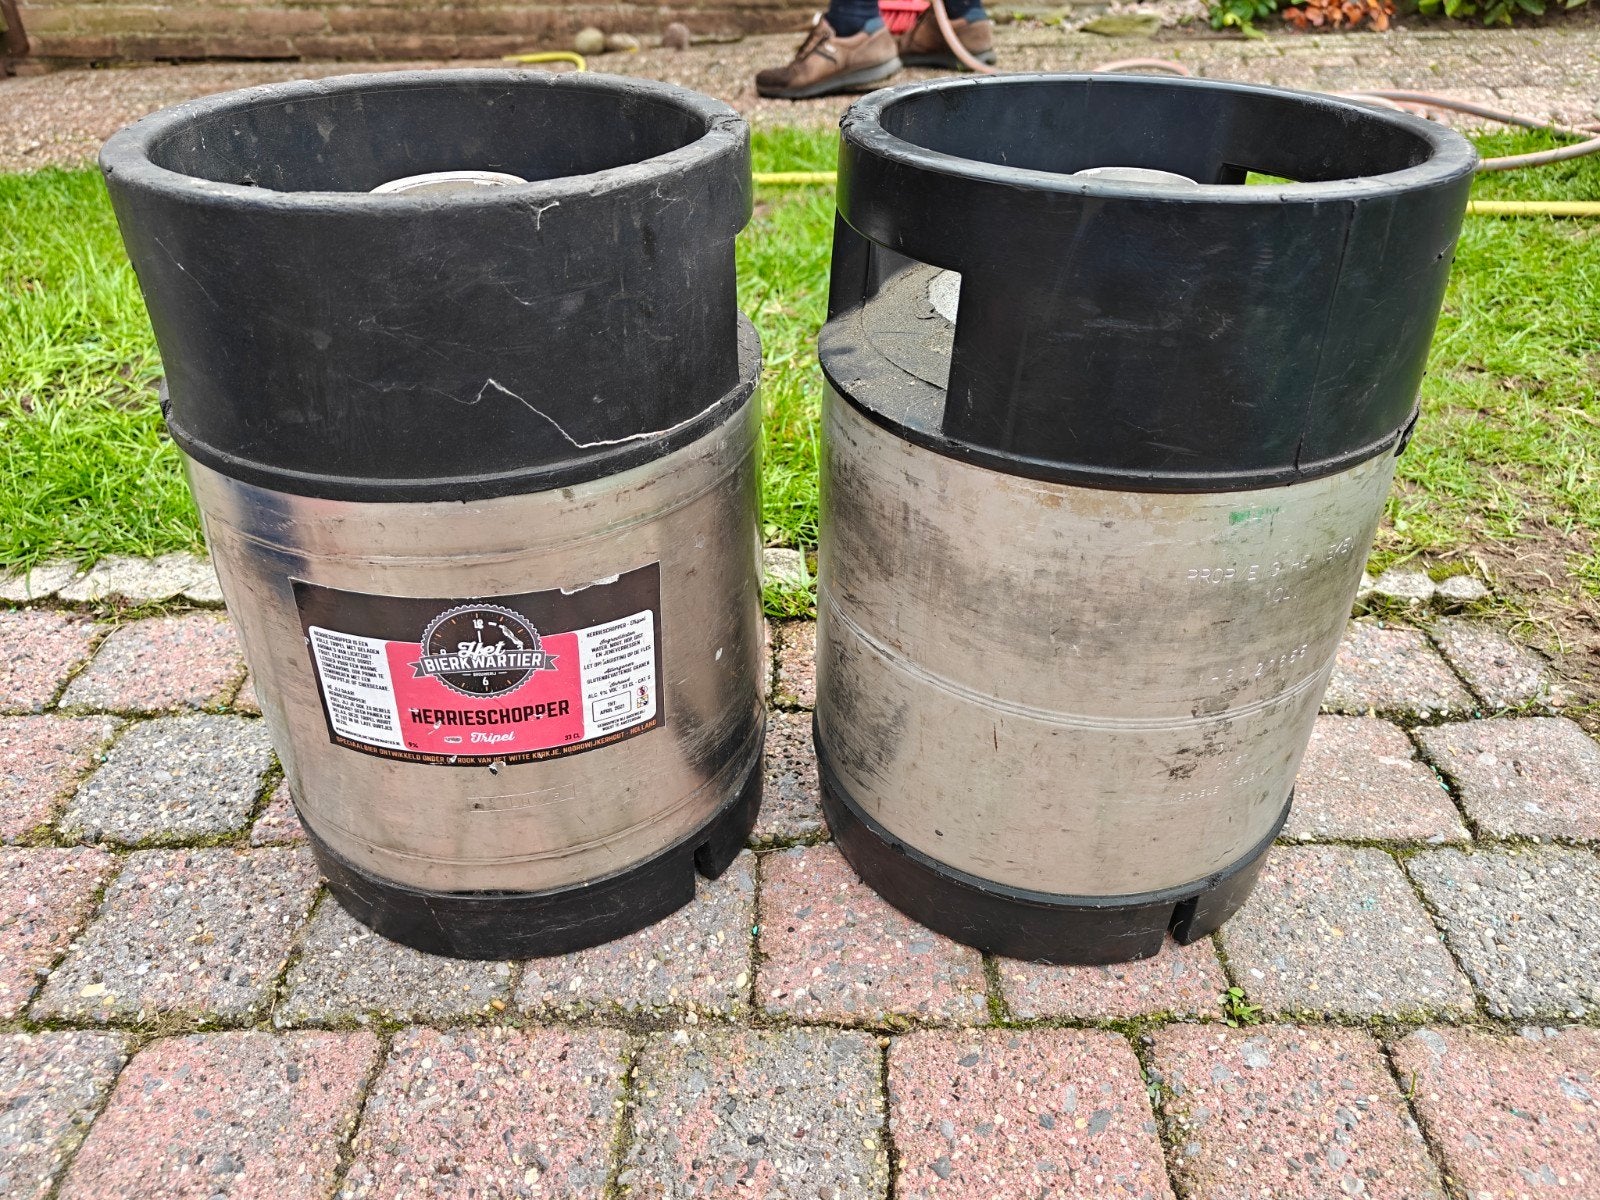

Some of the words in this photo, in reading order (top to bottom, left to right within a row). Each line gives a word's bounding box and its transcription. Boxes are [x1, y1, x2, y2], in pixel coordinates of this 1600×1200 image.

[587, 623, 627, 638] HERRIESCHOPPER
[457, 640, 505, 661] Het
[423, 652, 541, 672] BIERKWARTIER
[482, 677, 489, 686] 6
[410, 700, 570, 726] HERRIESCHOPPER
[336, 736, 378, 753] SPECIAALBIER
[379, 749, 421, 760] ONTWIKKELD
[422, 755, 444, 763] ONDER
[494, 755, 506, 763] HET
[563, 733, 625, 754] NOORDWIJKERHOUT
[630, 720, 657, 735] HOLLAND
[470, 731, 515, 744] Tripel
